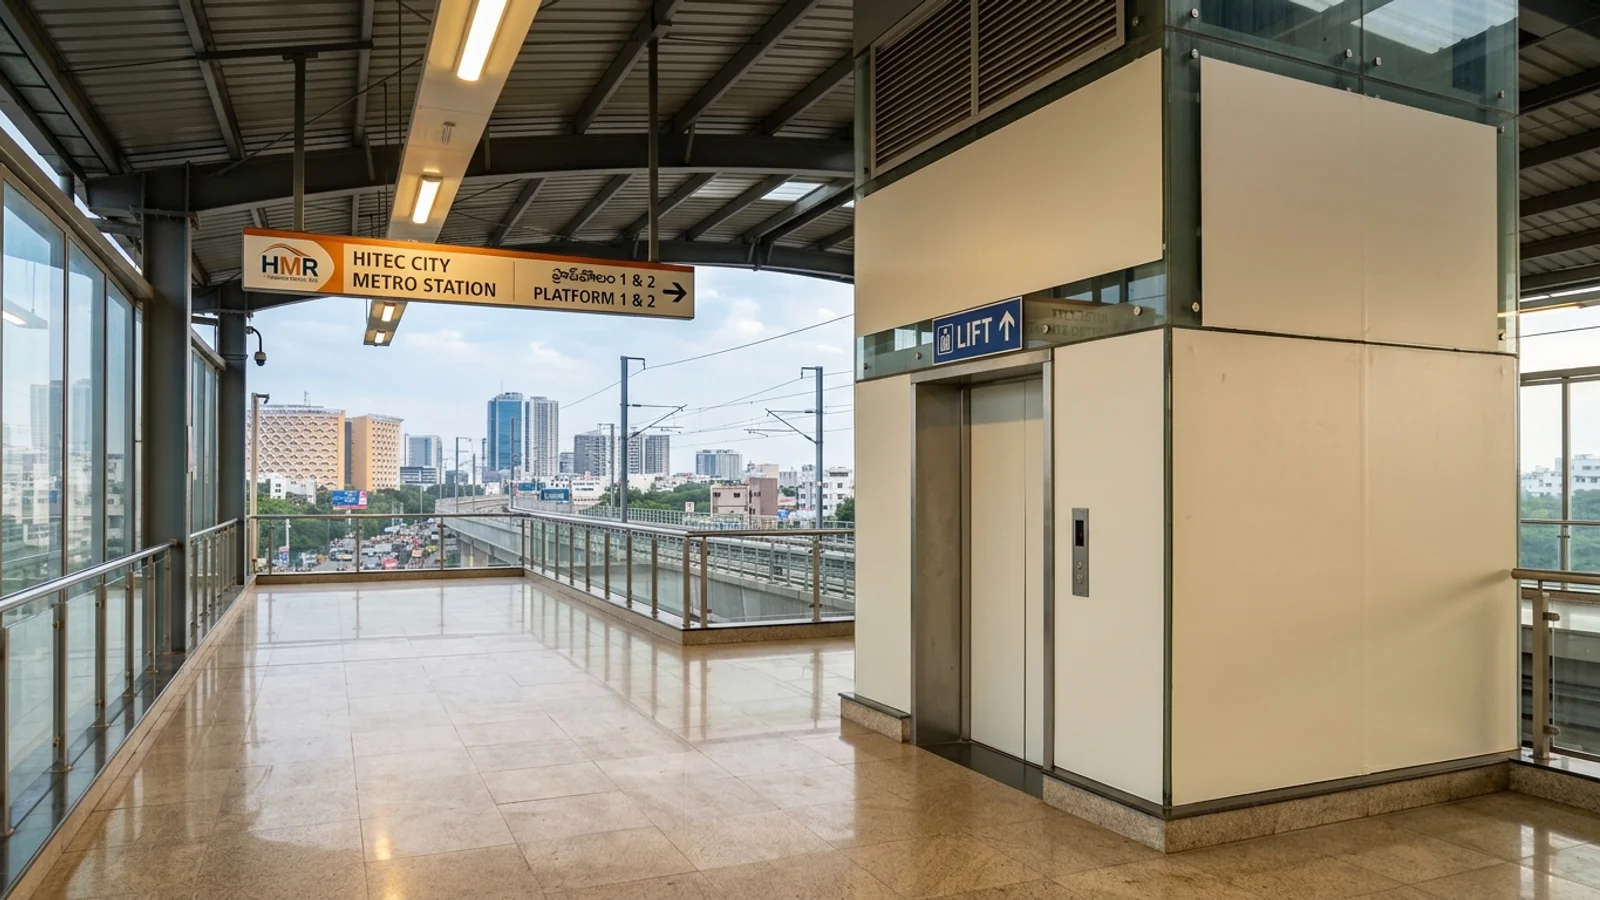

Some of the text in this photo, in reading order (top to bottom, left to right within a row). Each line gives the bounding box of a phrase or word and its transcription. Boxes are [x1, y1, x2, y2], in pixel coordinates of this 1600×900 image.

[262, 255, 319, 278] HMR
[353, 250, 451, 273] HITEC CITY
[353, 272, 496, 297] METRO STATION
[619, 274, 626, 286] 1
[632, 274, 643, 287] &
[647, 275, 655, 289] 2
[533, 286, 656, 308] PLATFORM 1 & 2
[957, 316, 993, 349] LIFT
